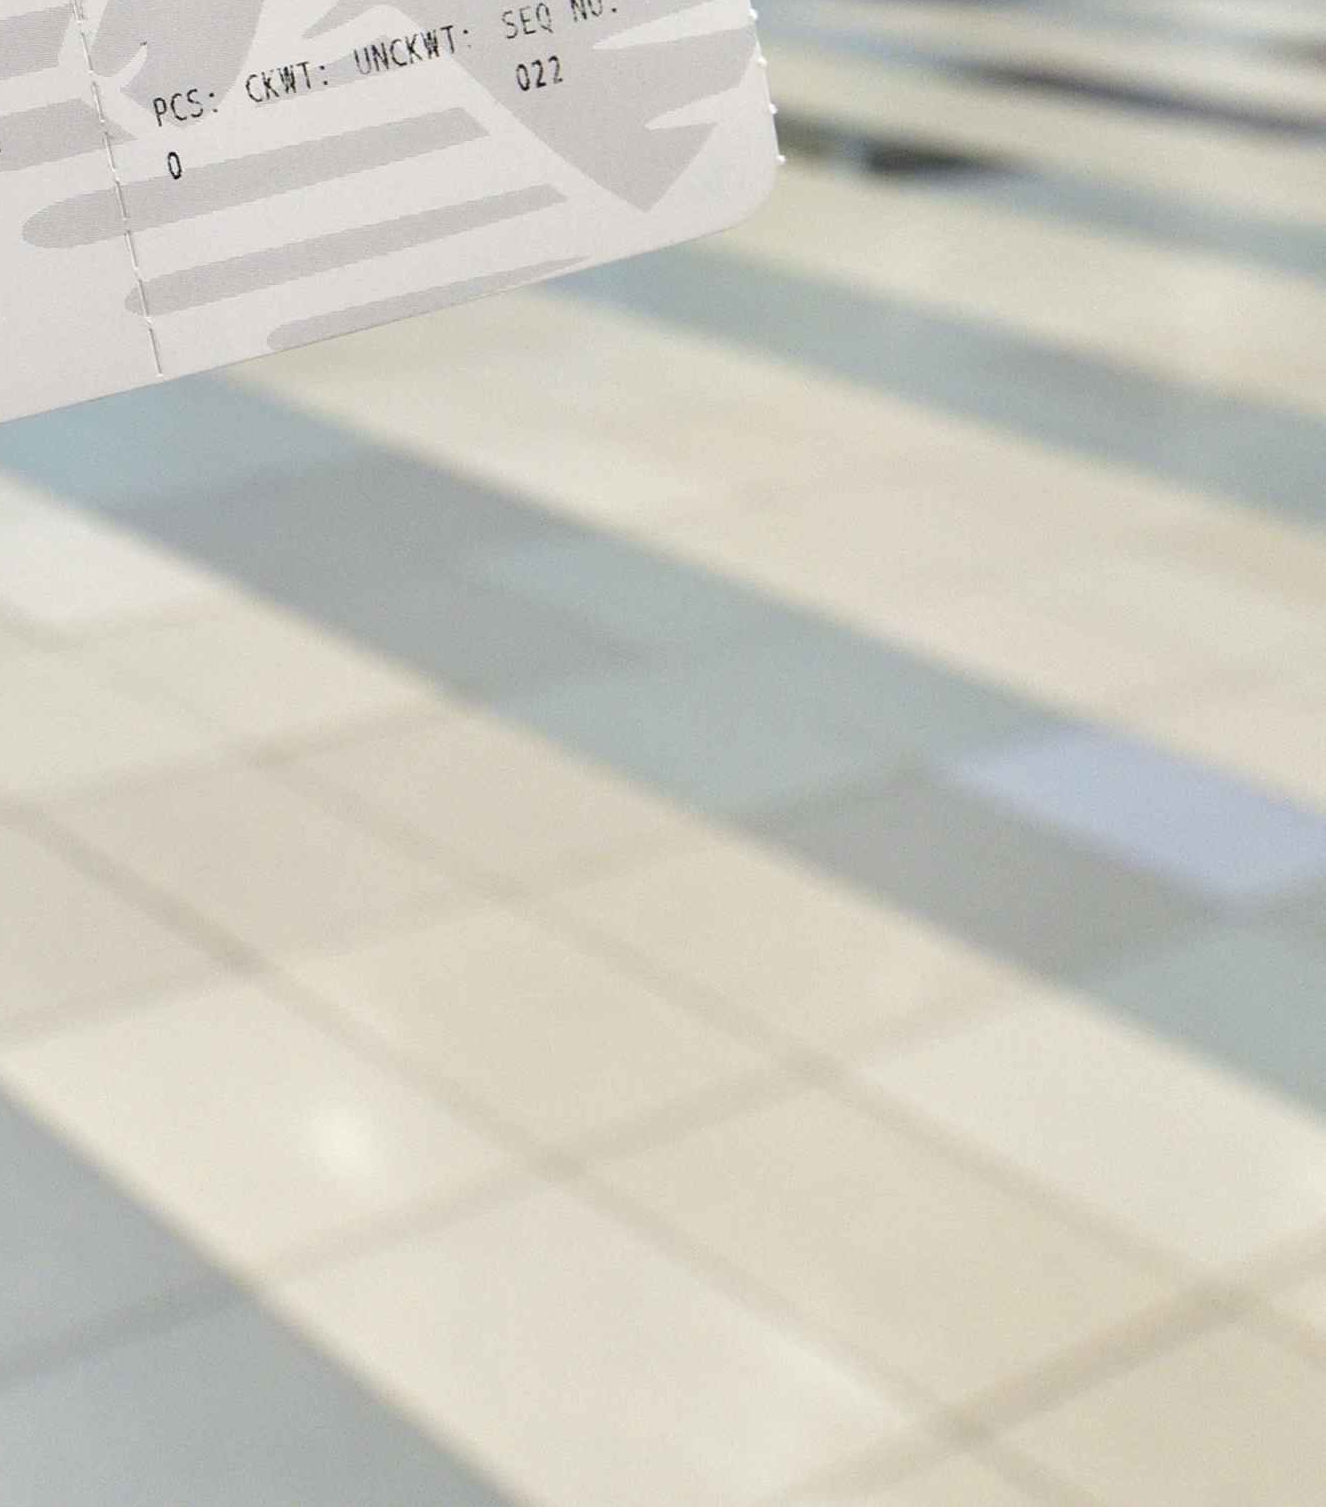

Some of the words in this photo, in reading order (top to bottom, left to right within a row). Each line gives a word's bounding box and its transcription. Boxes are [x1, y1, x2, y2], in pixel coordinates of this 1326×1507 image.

[153, 88, 218, 127] PCS:
[245, 60, 330, 104] CKWT:
[500, 2, 554, 40] SEQ
[515, 55, 565, 93] 022
[166, 150, 183, 181] 0
